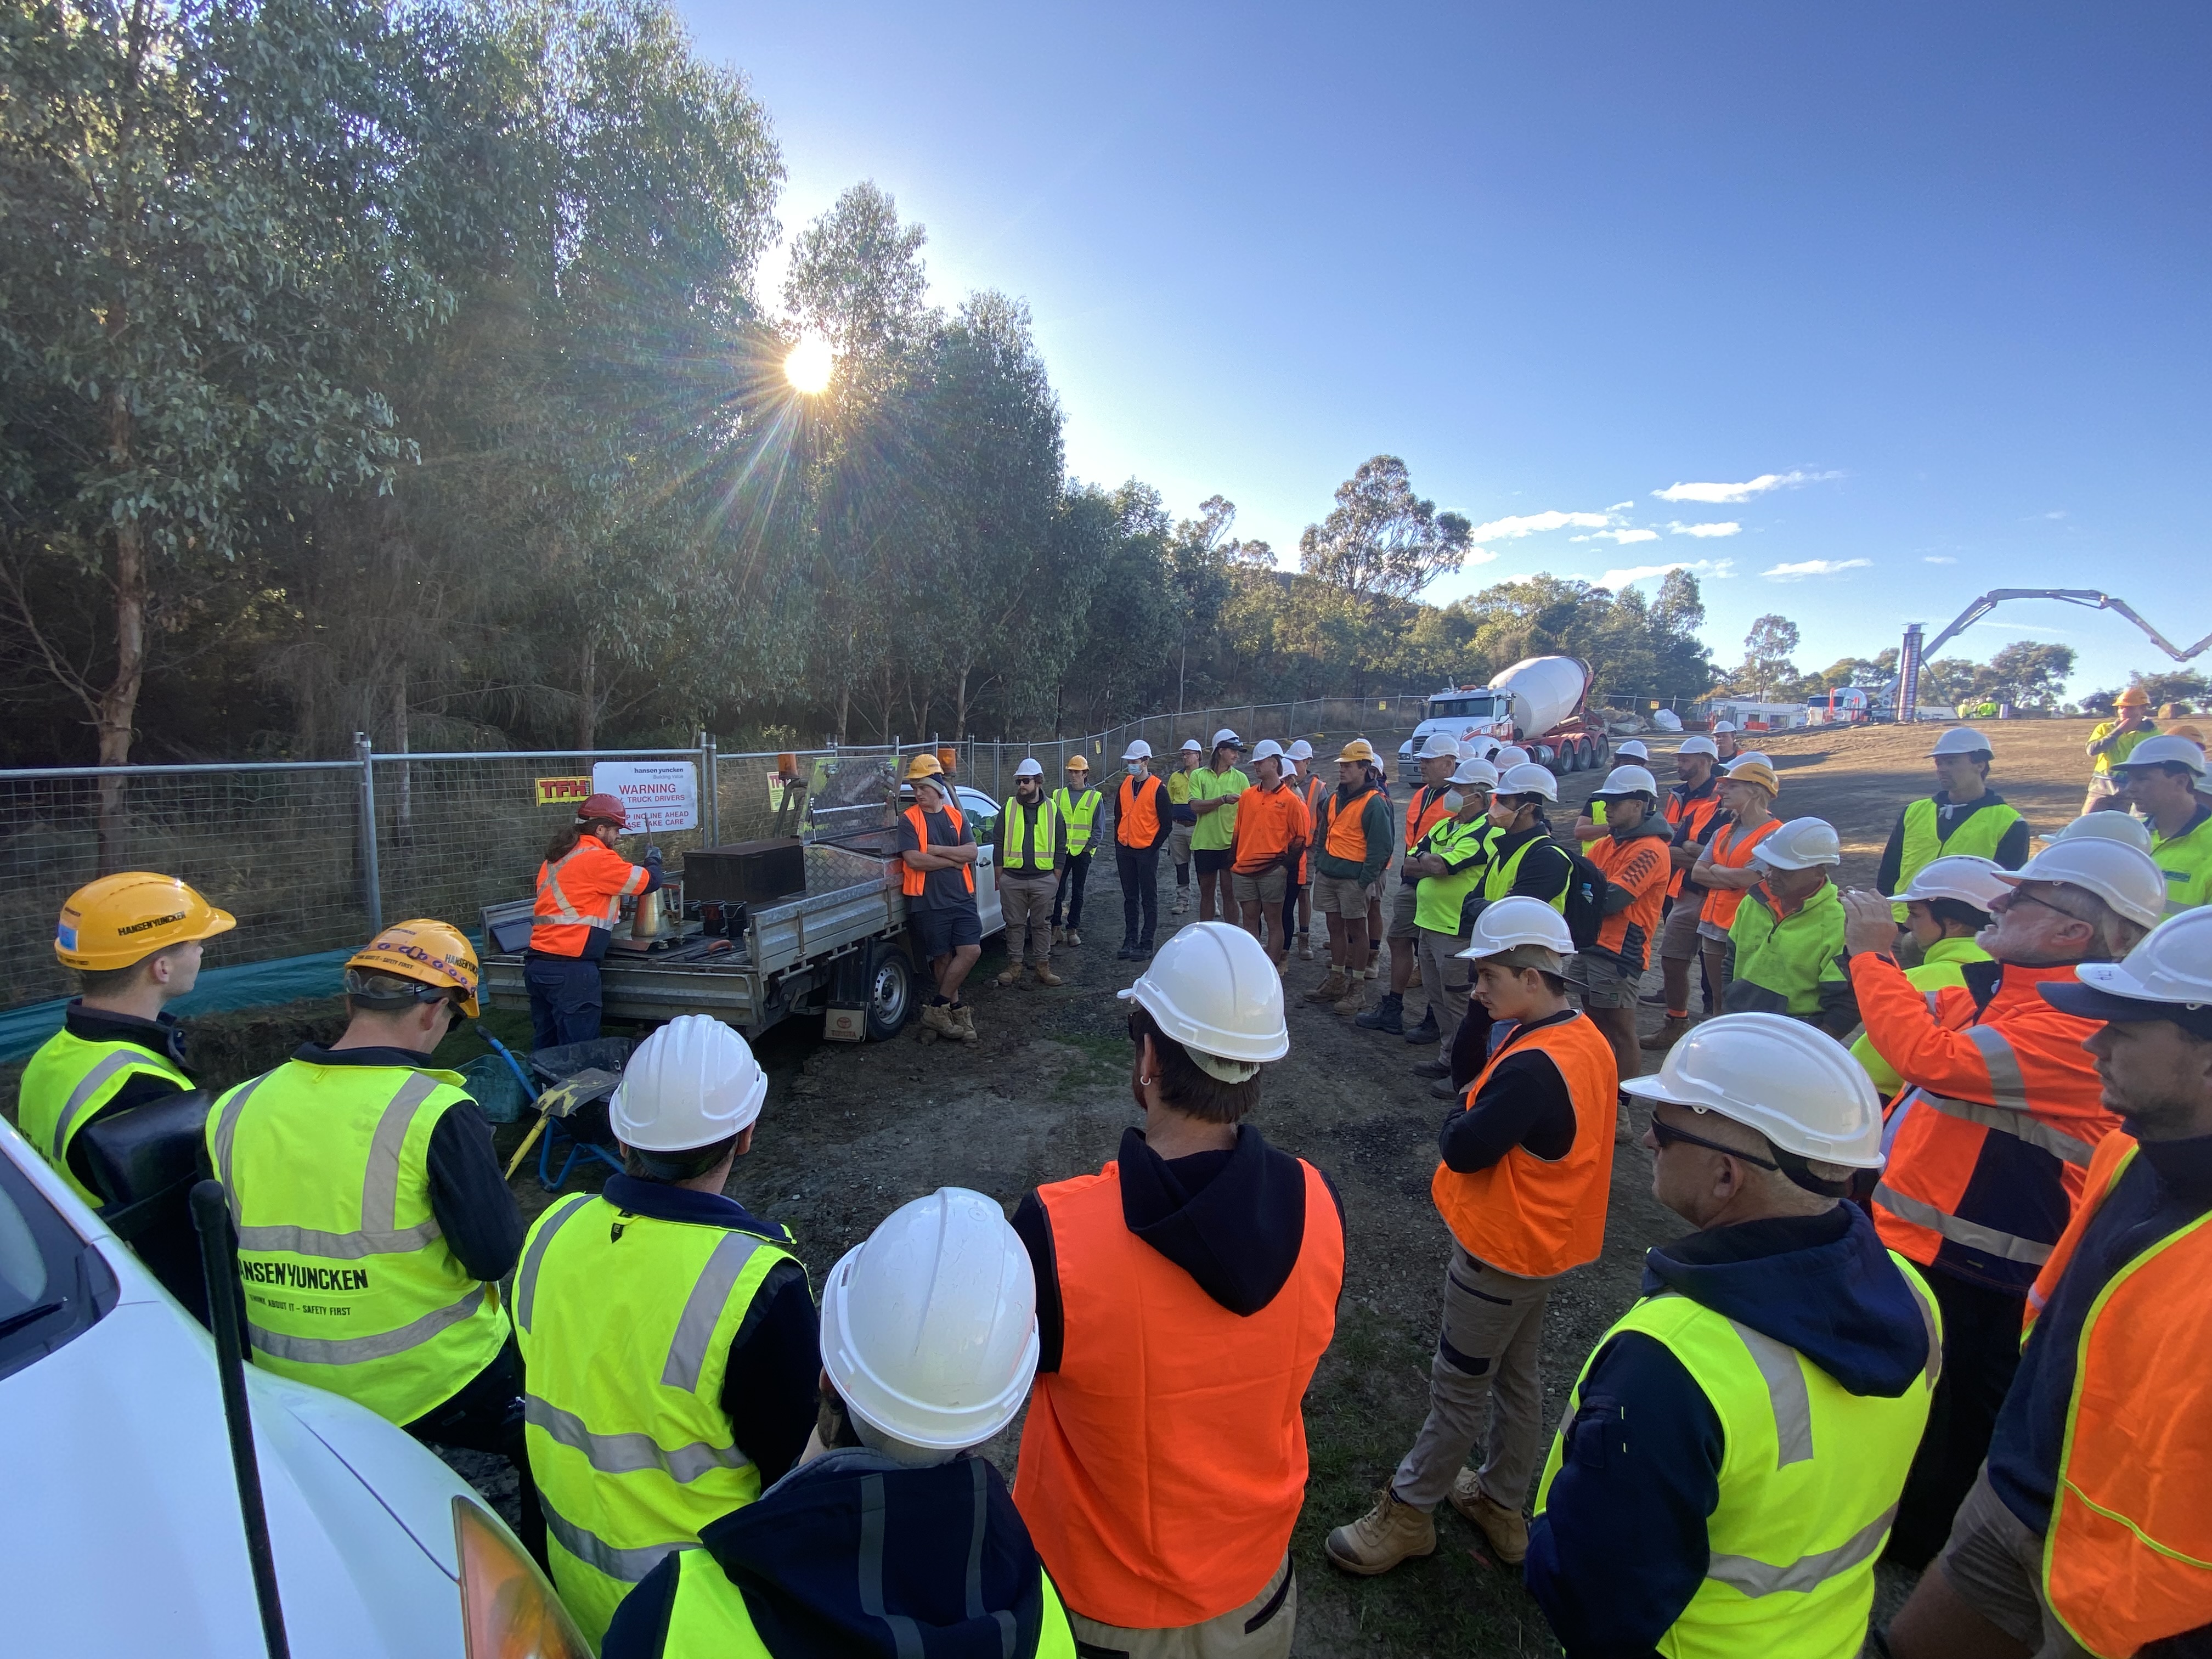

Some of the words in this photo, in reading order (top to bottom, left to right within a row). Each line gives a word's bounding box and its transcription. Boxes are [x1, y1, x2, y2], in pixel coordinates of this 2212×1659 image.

[539, 780, 585, 798] TFH
[619, 783, 676, 795] WARNING
[239, 1260, 368, 1290] ANSENYUNCKEN
[268, 1299, 287, 1311] ABOUT
[288, 1303, 295, 1312] IT
[302, 1305, 327, 1316] SAFETY
[329, 1307, 352, 1316] FIRST
